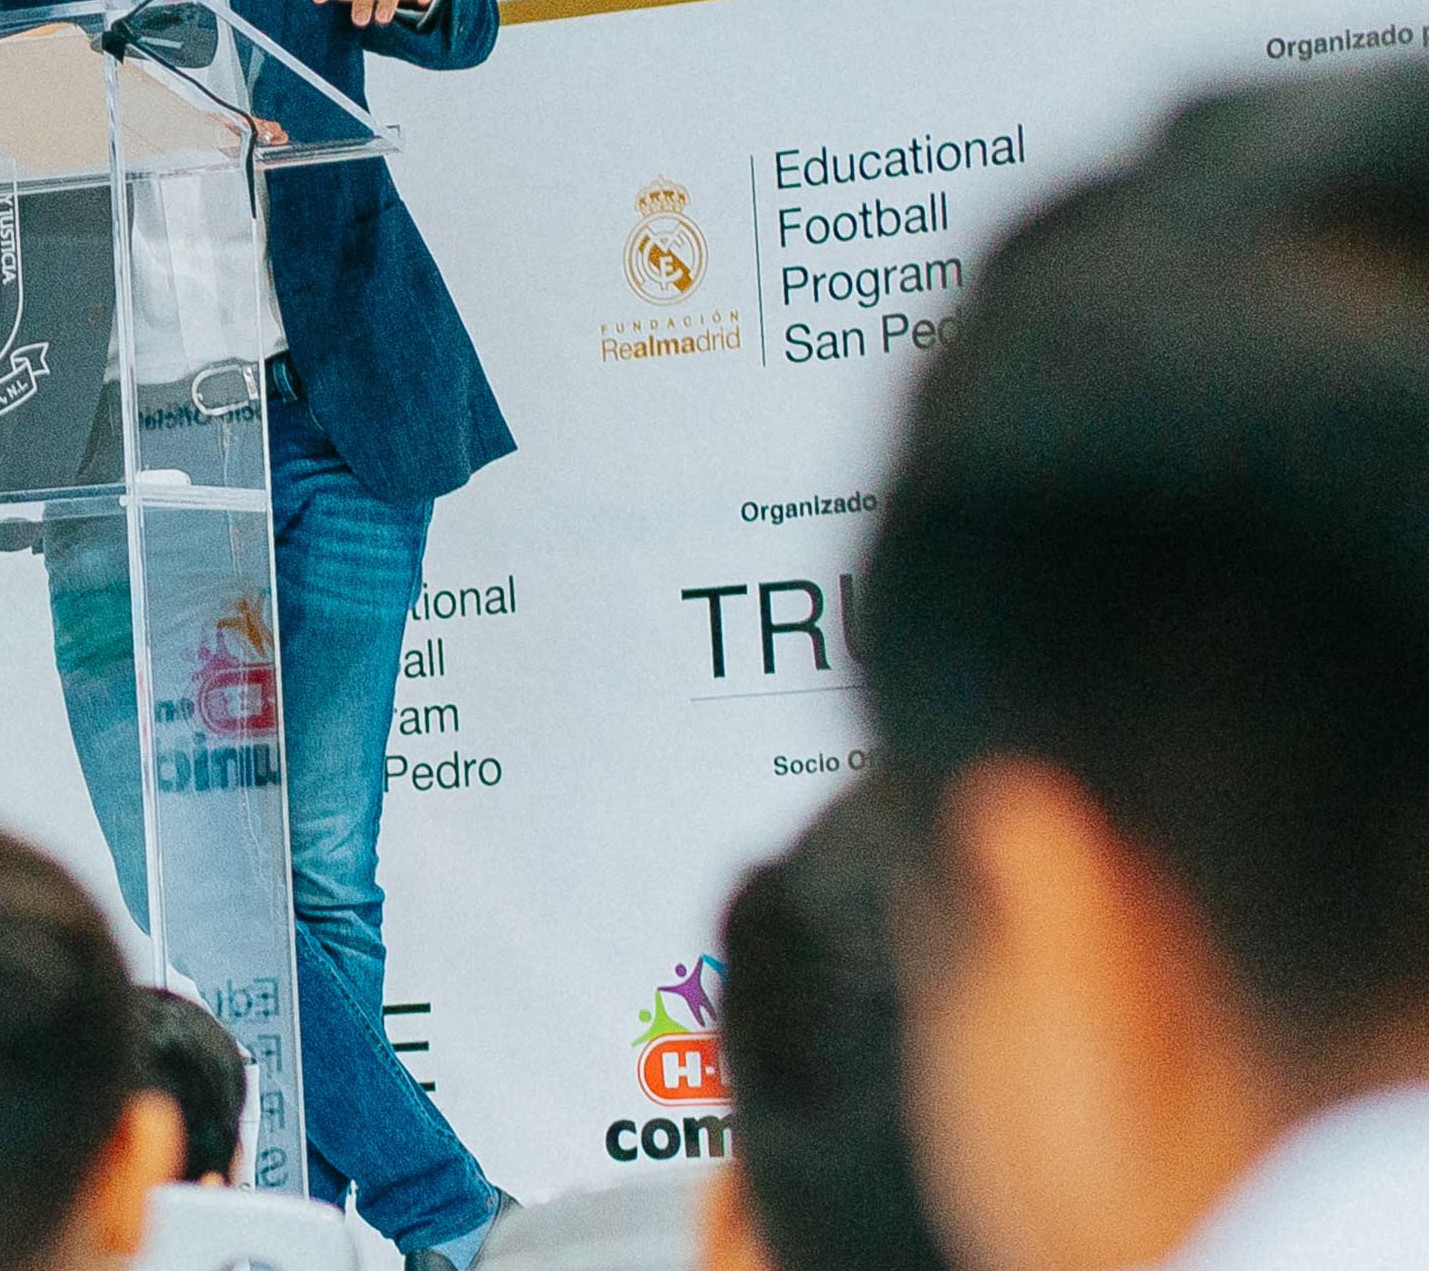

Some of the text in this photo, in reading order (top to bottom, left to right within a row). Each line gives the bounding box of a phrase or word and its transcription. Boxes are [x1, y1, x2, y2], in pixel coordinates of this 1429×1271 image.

[1266, 24, 1414, 61] Organizado
[775, 124, 1025, 189] Educational
[779, 191, 948, 248] Football
[782, 257, 963, 309] Program
[601, 326, 741, 363] Realmadrid
[785, 322, 866, 364] San
[741, 491, 878, 525] Organizado
[384, 750, 502, 793] Pedro
[773, 752, 840, 777] Socio
